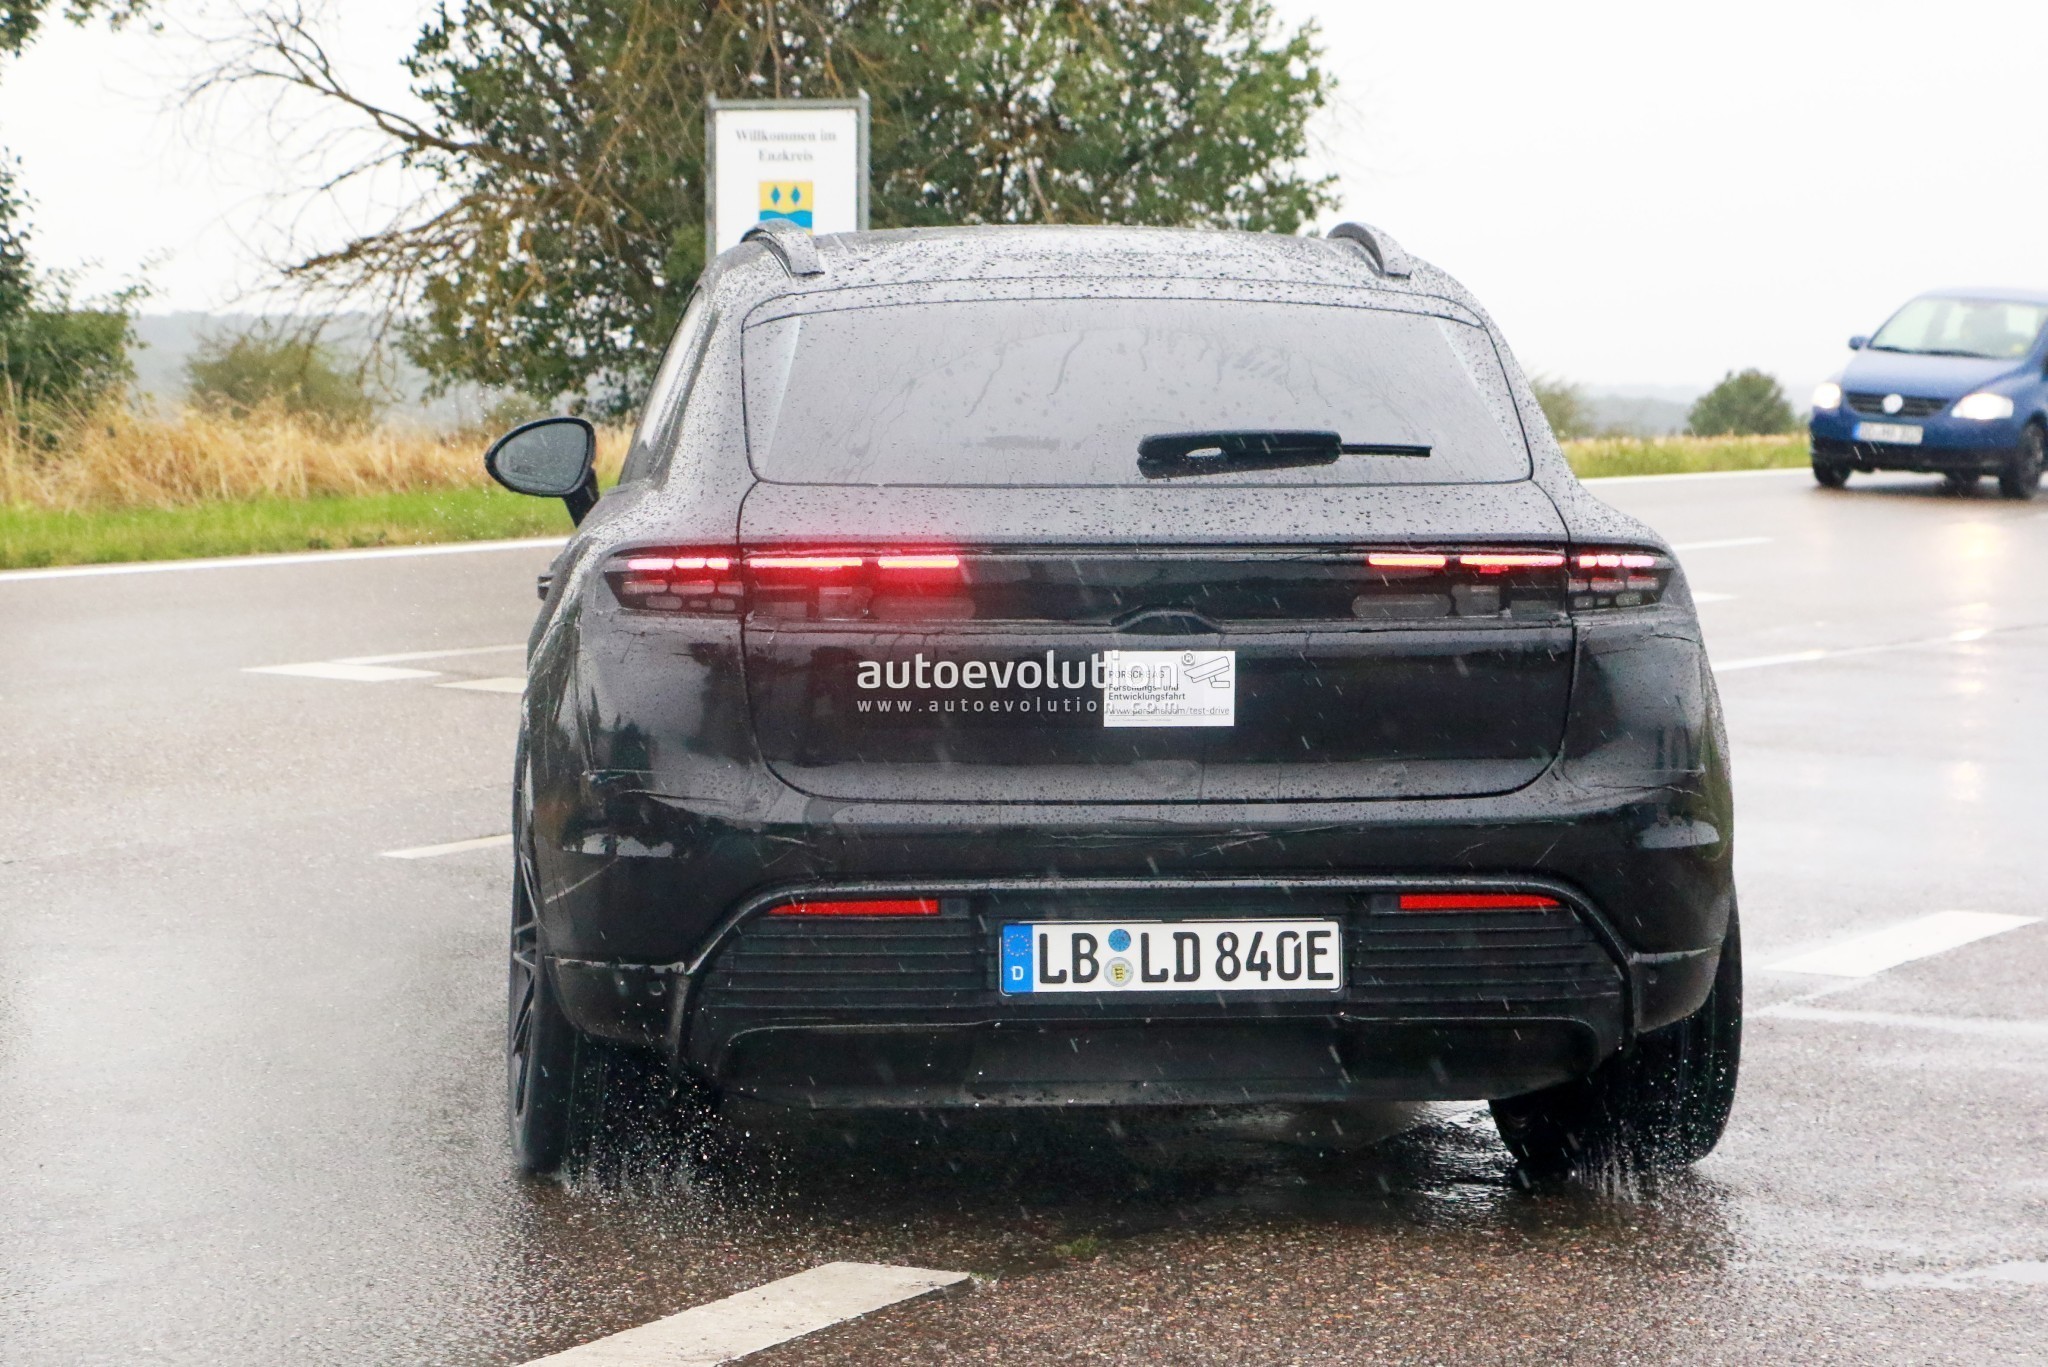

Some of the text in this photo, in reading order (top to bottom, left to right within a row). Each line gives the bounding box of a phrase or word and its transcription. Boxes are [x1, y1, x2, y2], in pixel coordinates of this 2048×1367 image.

[736, 129, 837, 142] Willkommen im
[758, 149, 814, 162] Enzkreis
[1109, 692, 1186, 702] Entwicklungsfahrt
[1039, 930, 1334, 984] LB LD 840E
[1012, 966, 1024, 979] D
